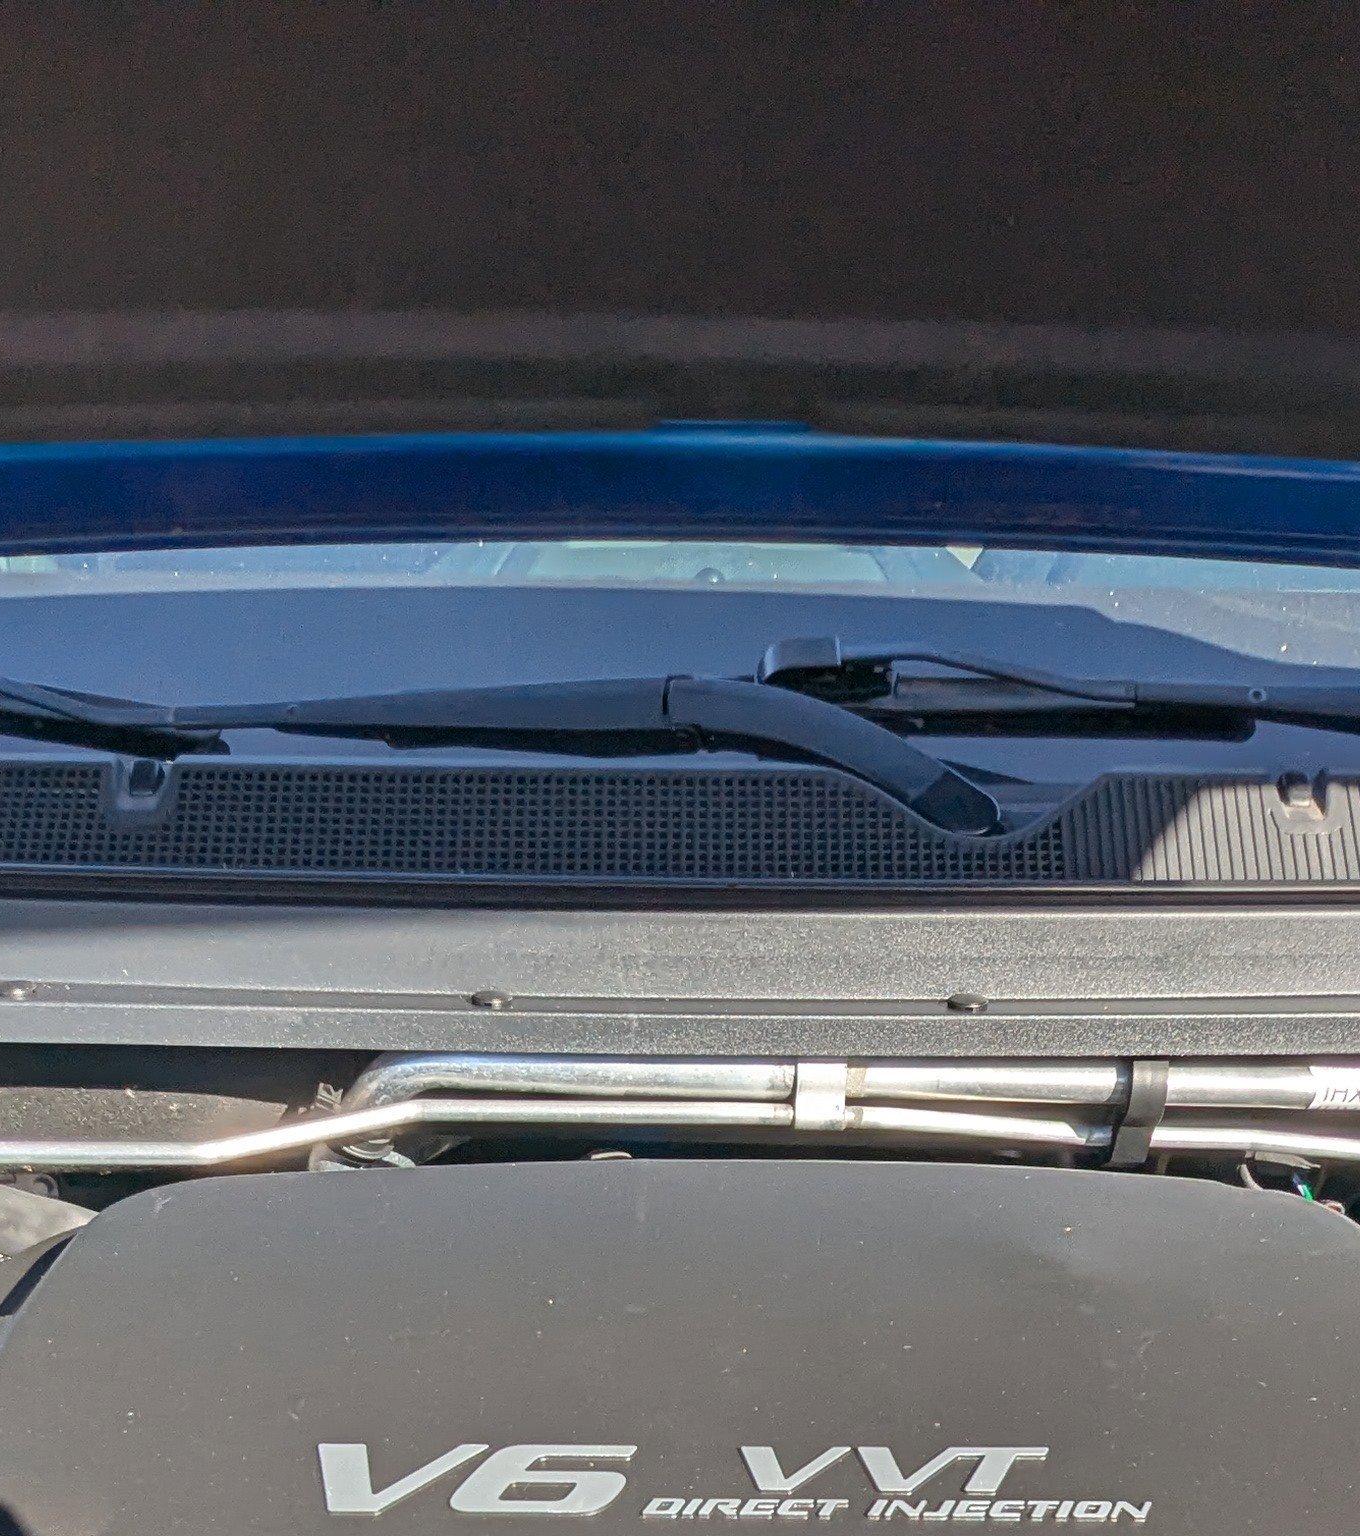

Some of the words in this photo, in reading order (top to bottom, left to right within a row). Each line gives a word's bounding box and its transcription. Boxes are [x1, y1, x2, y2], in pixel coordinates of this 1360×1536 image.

[316, 1442, 638, 1518] V6
[737, 1445, 1050, 1496] VVT
[641, 1496, 849, 1521] DIRECT
[865, 1498, 1153, 1523] INJECTION
